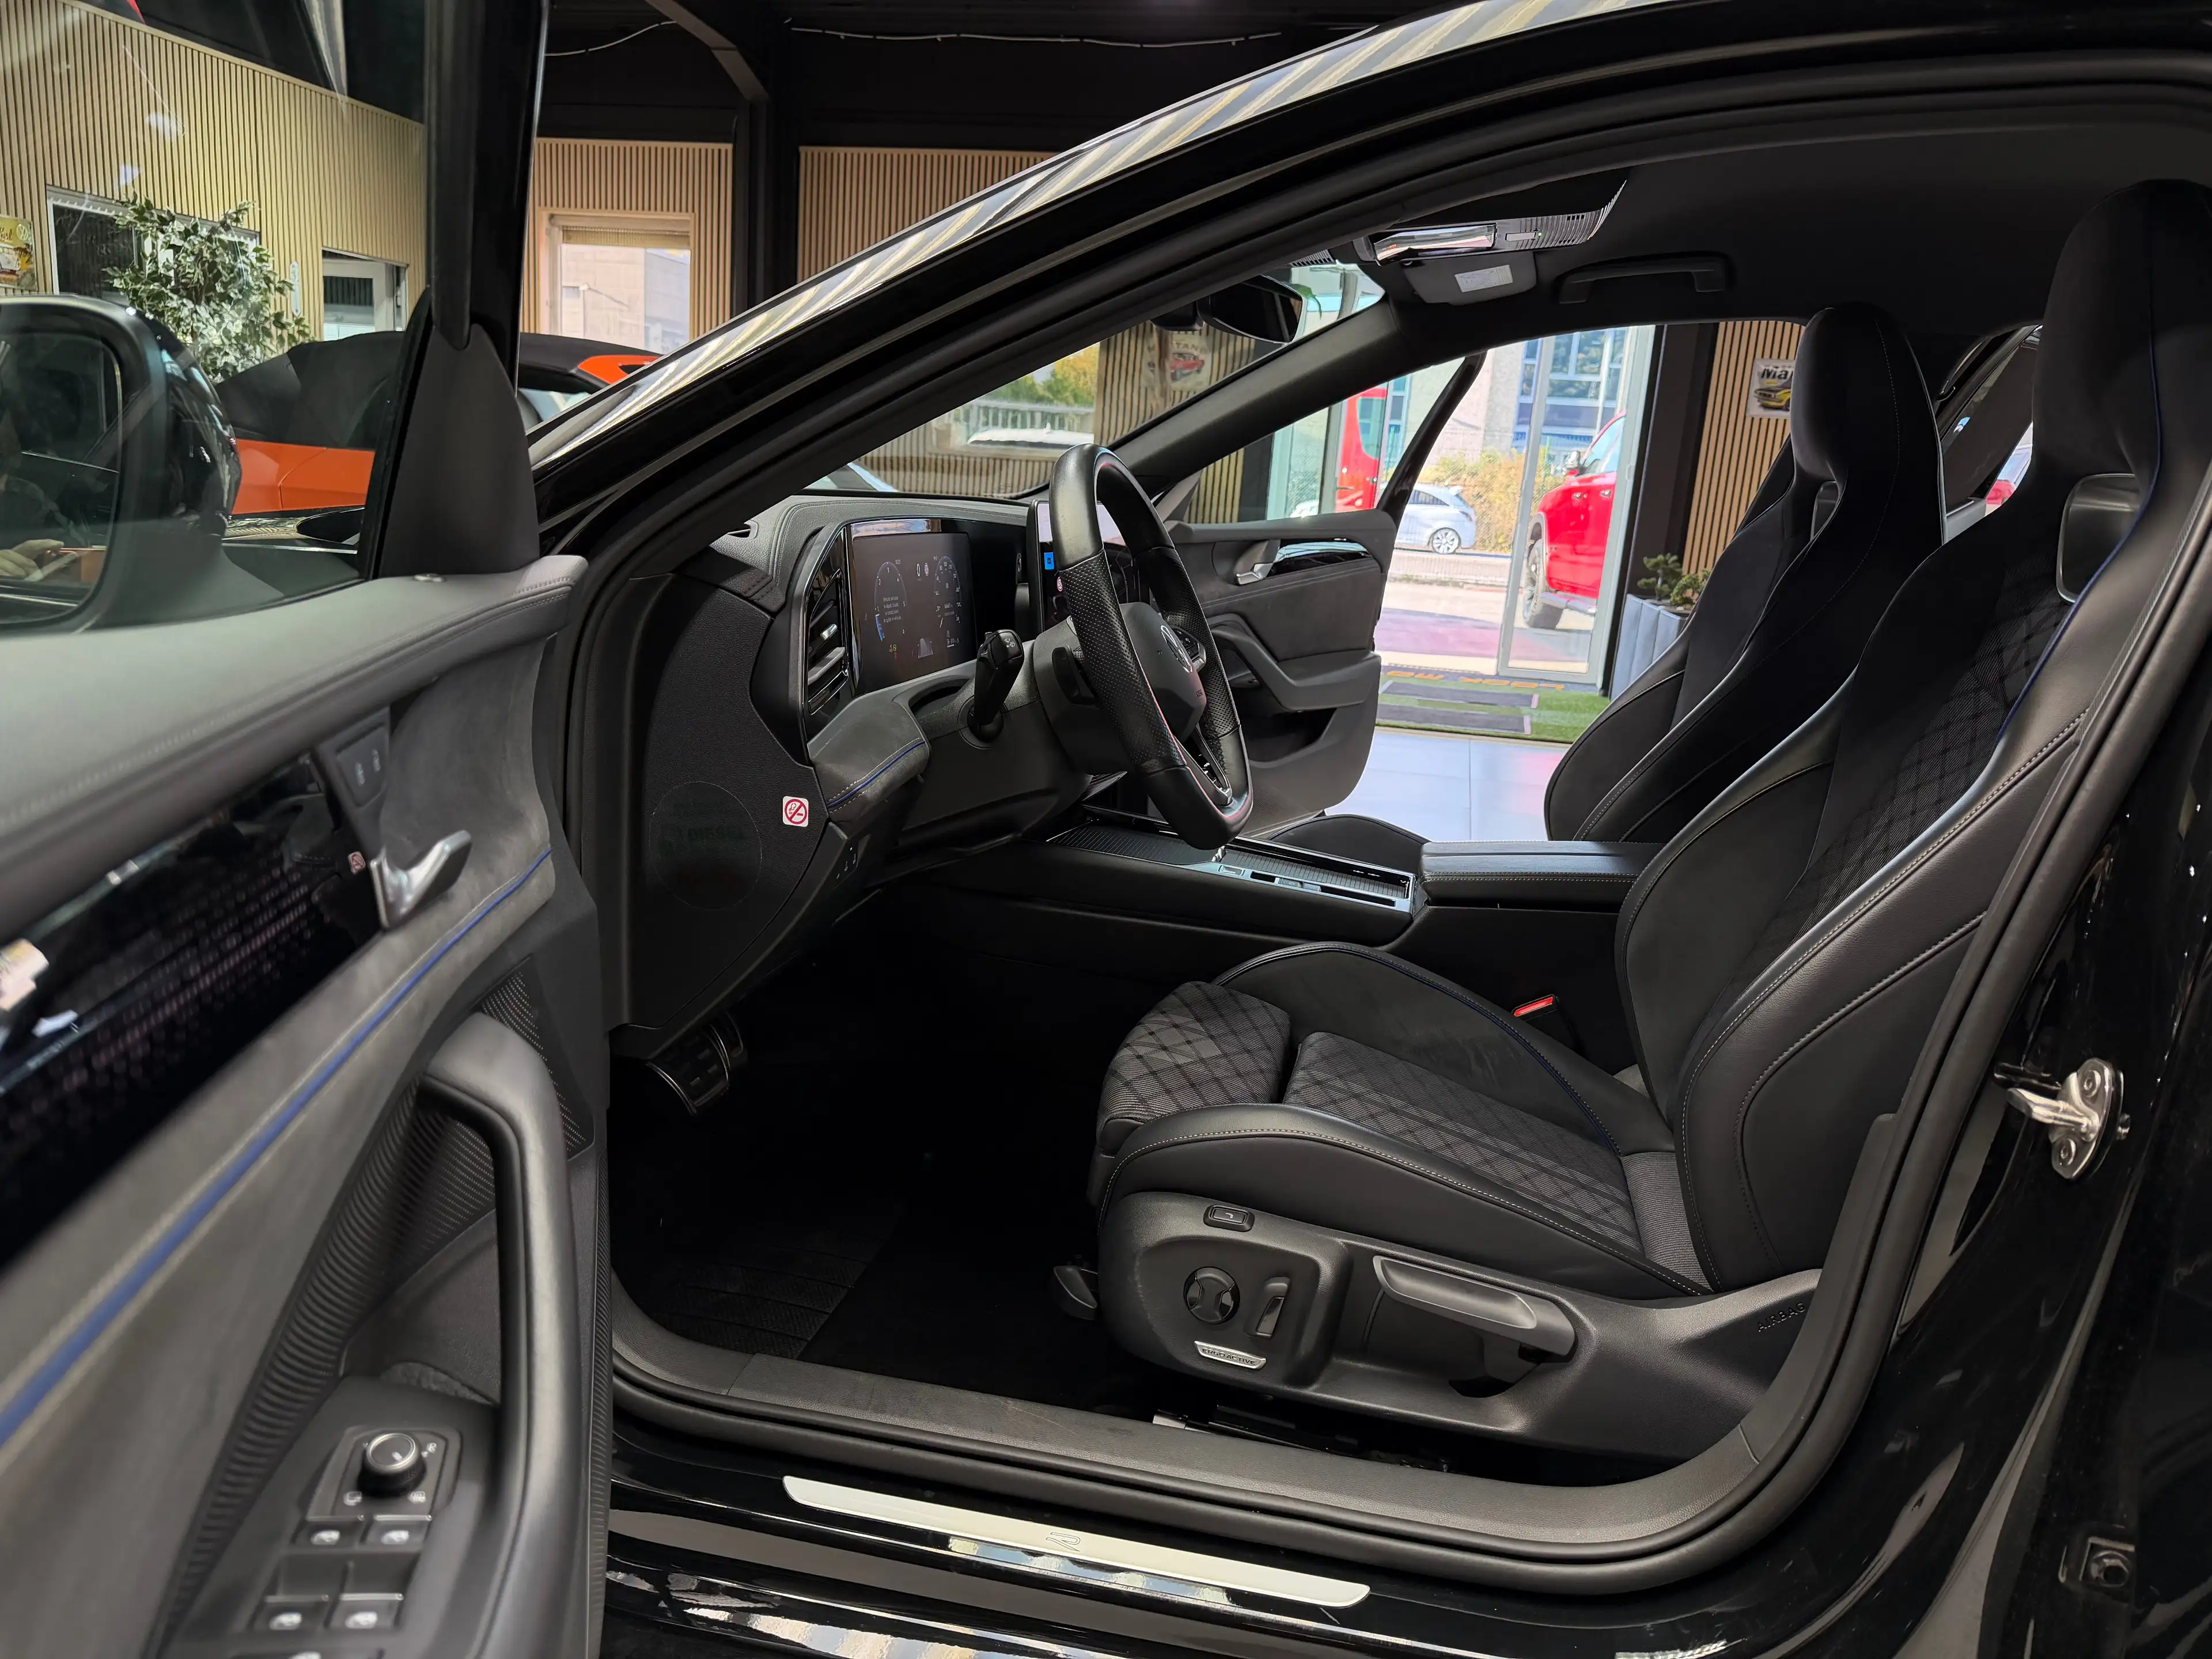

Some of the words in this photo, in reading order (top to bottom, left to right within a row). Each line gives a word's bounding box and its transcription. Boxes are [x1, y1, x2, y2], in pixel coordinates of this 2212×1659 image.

[1761, 368, 1794, 380] Ma
[1758, 1301, 1806, 1332] AIRBAG
[1202, 1347, 1225, 1358] ERGO
[1226, 1354, 1256, 1365] ACTIVE
